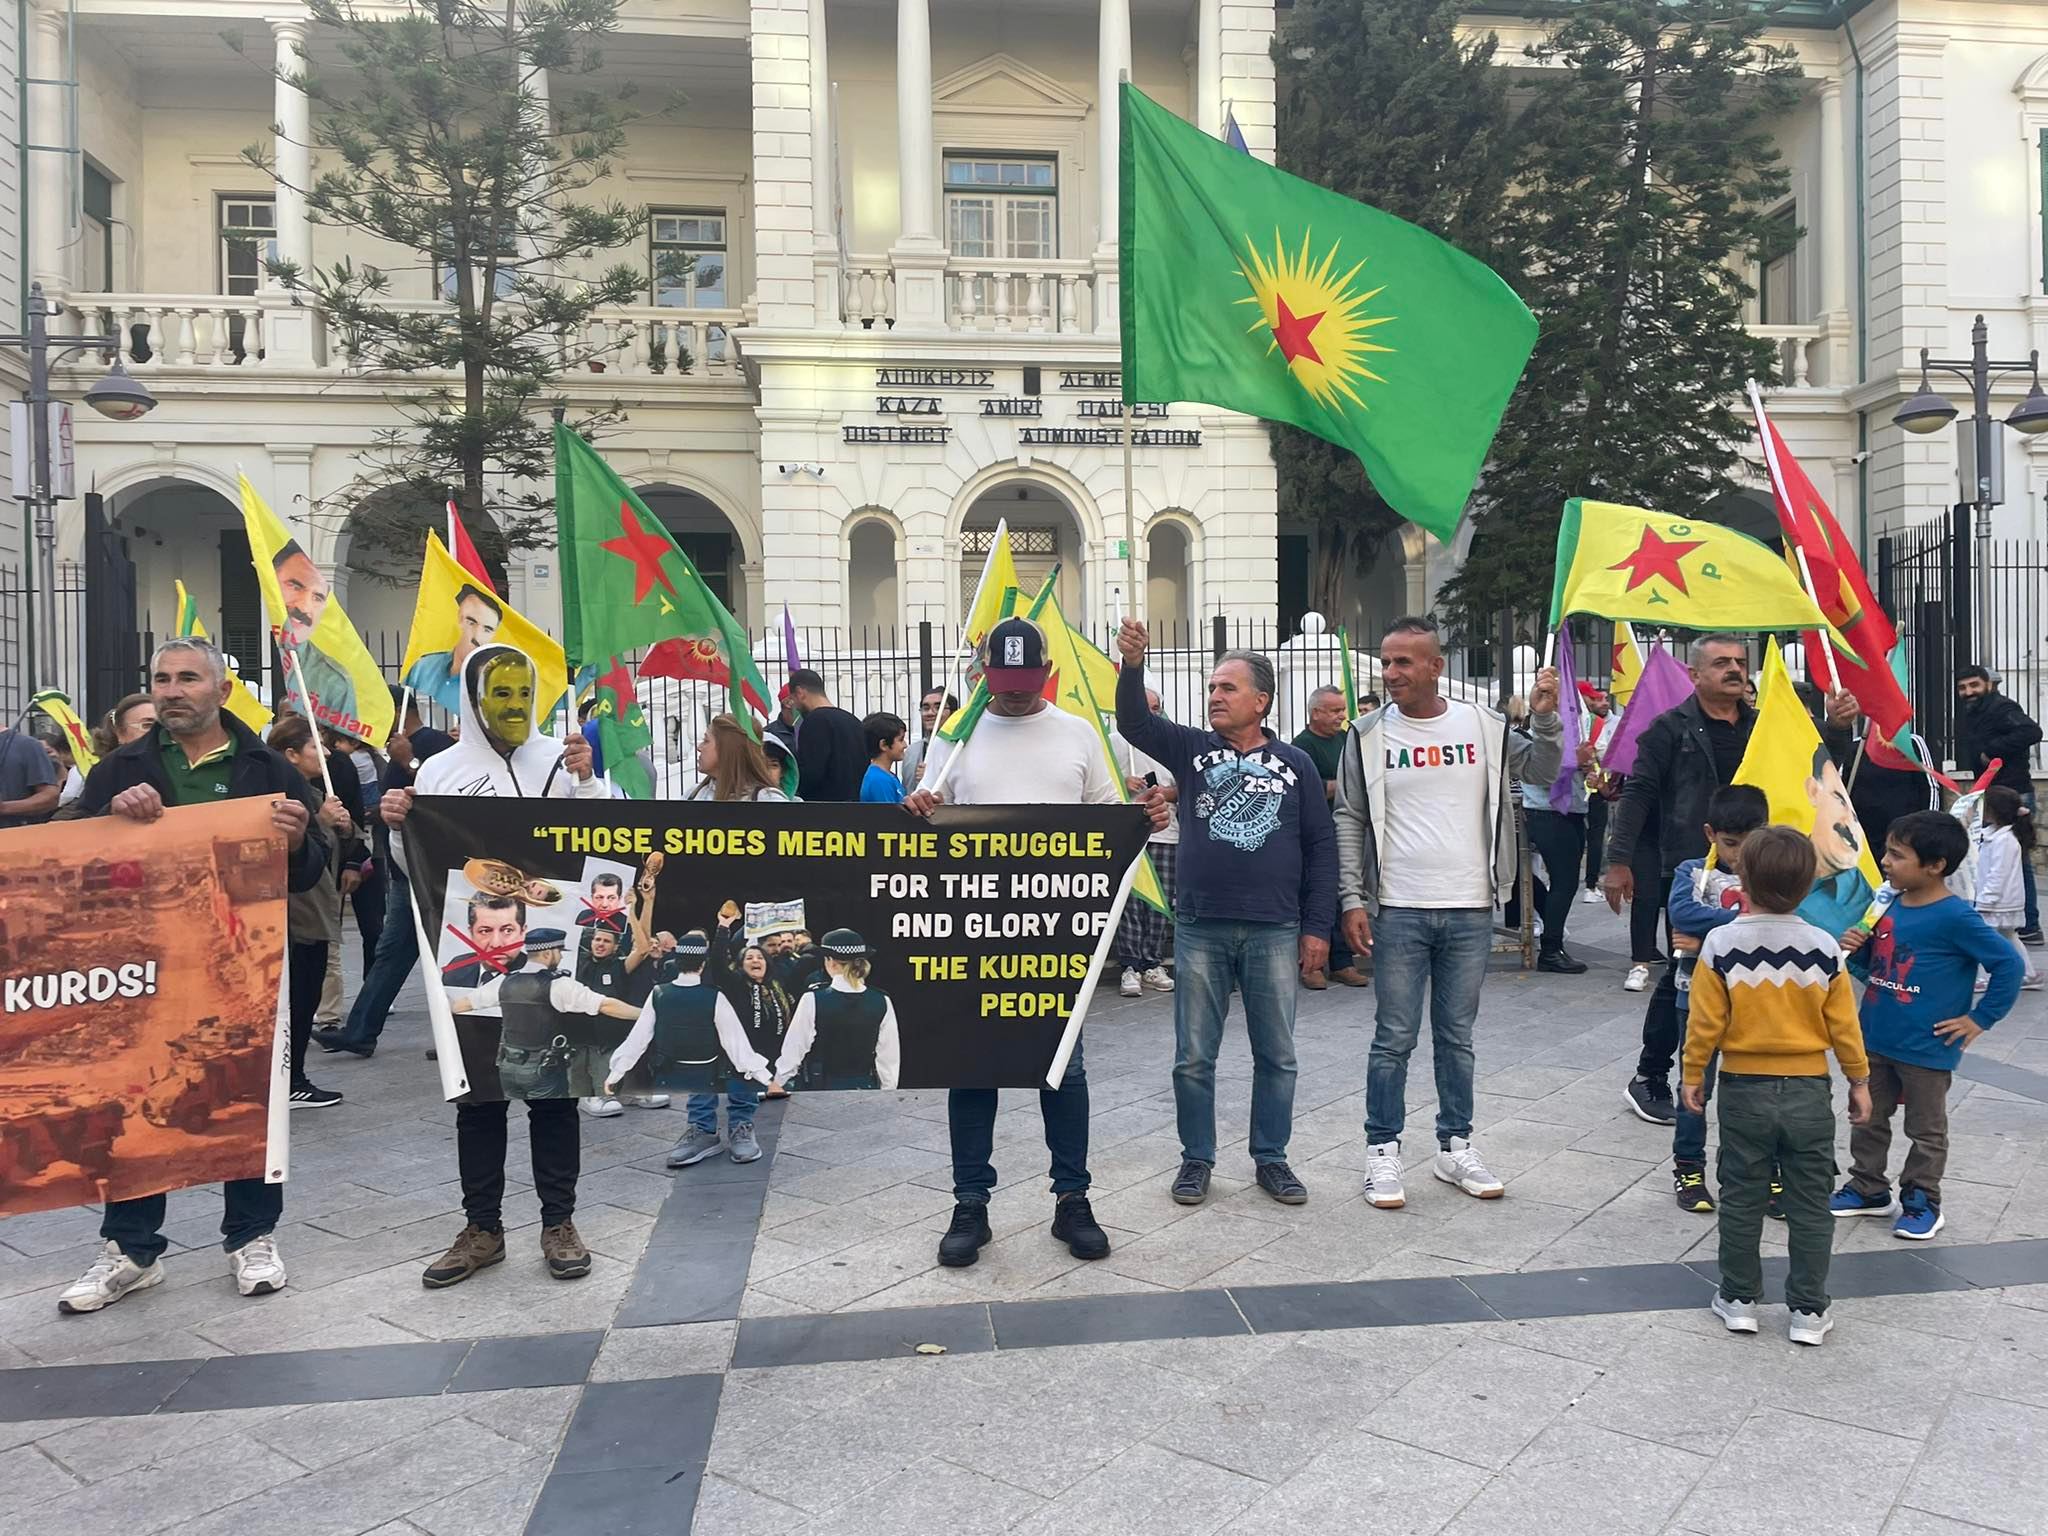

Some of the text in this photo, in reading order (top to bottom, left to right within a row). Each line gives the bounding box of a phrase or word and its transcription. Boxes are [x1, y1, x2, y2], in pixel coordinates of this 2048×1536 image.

[877, 397, 941, 415] KAZA
[843, 427, 951, 443] DISTRICT
[1386, 742, 1475, 769] LACOSTE
[1244, 775, 1285, 794] 258
[1211, 821, 1271, 838] NIGHT CLUB
[1243, 808, 1273, 829] PARTY
[664, 828, 766, 856] SHOES
[778, 830, 872, 857] MEAN
[877, 833, 938, 858] THE
[949, 832, 1112, 860] STRUGGLE,
[870, 873, 1110, 898] FOR THE HONOR
[892, 911, 1109, 938] AND GLORY OF
[909, 954, 1095, 981] THE KURDIS
[4, 960, 157, 1013] KURDS!
[981, 992, 1080, 1017] PEOPL
